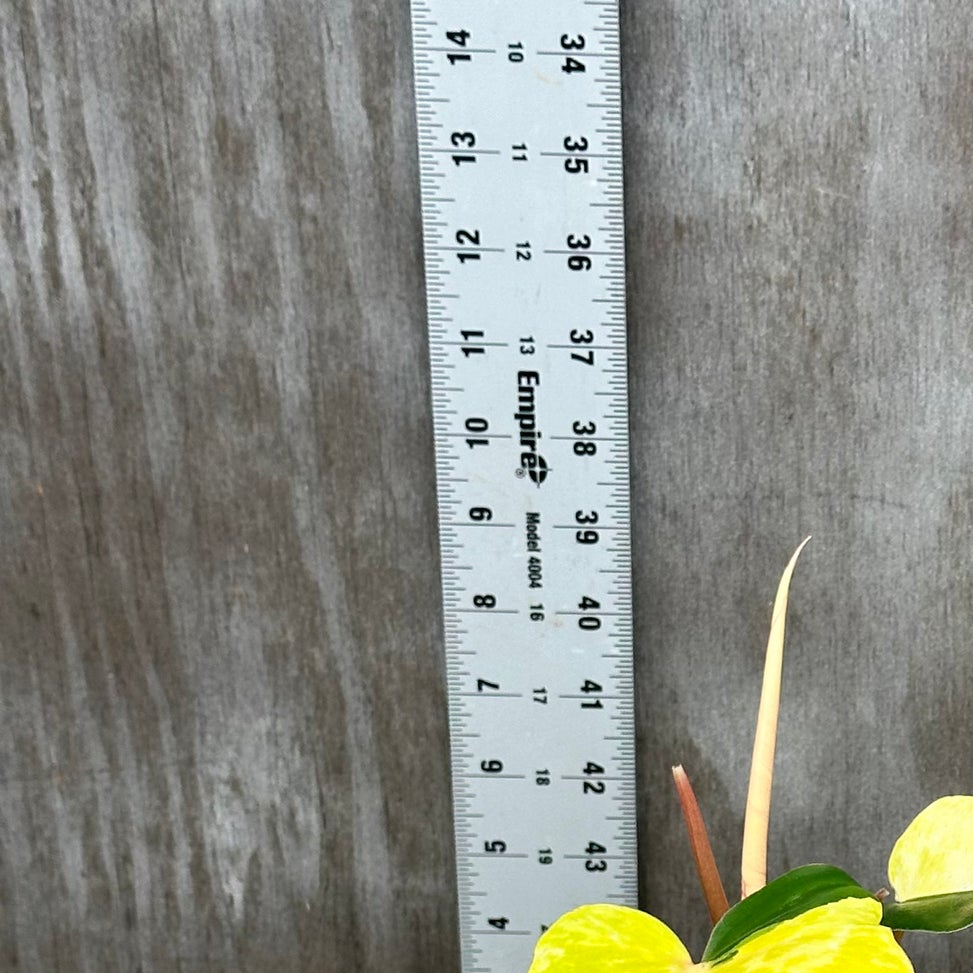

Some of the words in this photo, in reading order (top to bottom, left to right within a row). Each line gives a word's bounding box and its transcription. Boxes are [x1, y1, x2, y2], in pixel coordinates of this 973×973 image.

[446, 29, 471, 65] 14
[508, 42, 524, 63] 10
[560, 34, 586, 74] 34
[450, 132, 476, 166] 13
[512, 144, 528, 161] 11
[563, 136, 589, 174] 35
[455, 230, 481, 264] 12
[516, 242, 532, 261] 12
[566, 234, 592, 271] 36
[460, 330, 485, 357] 11
[519, 336, 535, 355] 13
[569, 329, 594, 366] 37
[464, 417, 489, 449] 10
[514, 370, 543, 469] Empire
[572, 421, 597, 456] 38
[469, 507, 493, 521] 9
[575, 510, 599, 545] 39
[526, 512, 541, 552] Model
[527, 556, 542, 589] 4004
[473, 594, 496, 609] 8
[529, 604, 545, 621] 16
[578, 596, 601, 631] 40
[477, 678, 500, 692] 7
[533, 688, 547, 704] 17
[580, 679, 603, 709] 41
[480, 760, 503, 773] 6
[535, 769, 550, 786] 18
[582, 761, 605, 794] 42
[484, 840, 507, 853] 5
[538, 849, 553, 865] 19
[584, 841, 607, 872] 43
[487, 917, 509, 930] 4
